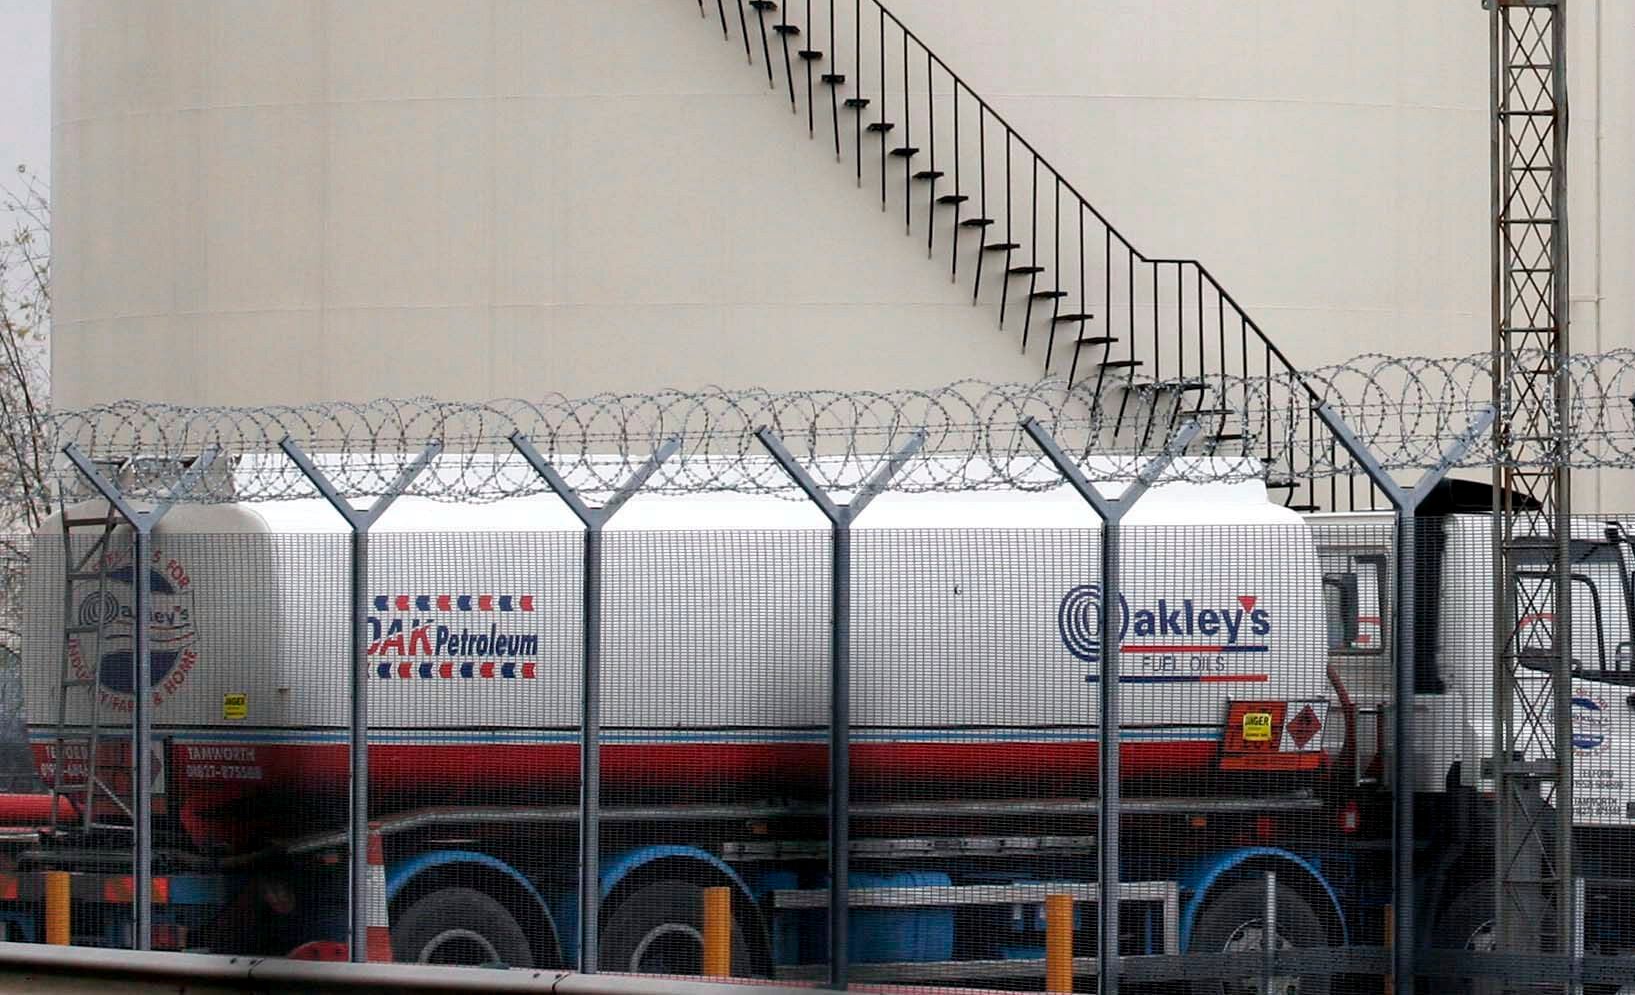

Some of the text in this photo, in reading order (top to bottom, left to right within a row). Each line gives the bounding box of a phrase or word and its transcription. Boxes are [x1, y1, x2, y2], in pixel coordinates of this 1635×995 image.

[435, 623, 539, 656] Petroleum
[164, 647, 199, 695] HOME
[1142, 657, 1225, 672] FUEL OILS
